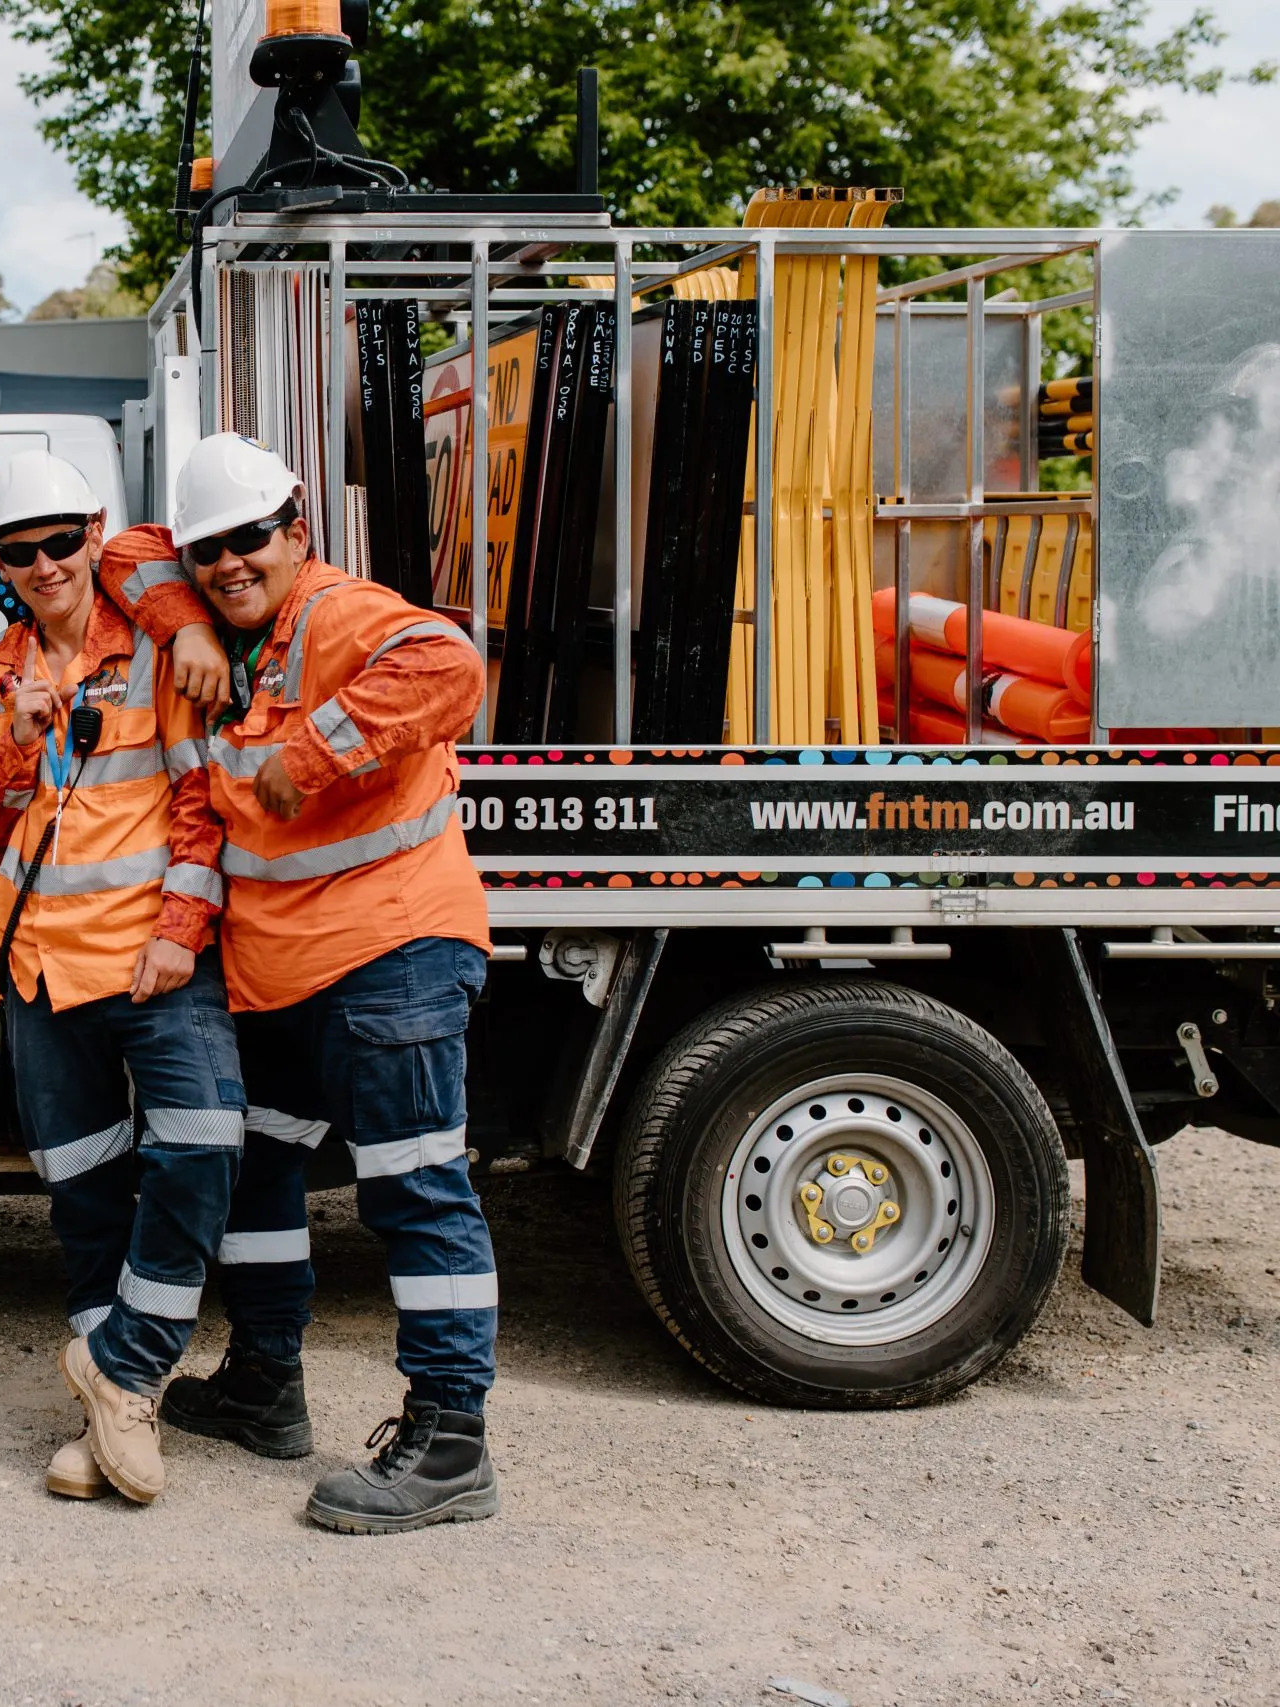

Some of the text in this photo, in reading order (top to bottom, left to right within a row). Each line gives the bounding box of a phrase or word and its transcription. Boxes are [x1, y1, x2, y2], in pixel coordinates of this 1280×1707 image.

[590, 324, 605, 387] MERGE
[693, 311, 708, 363] 17 PED
[714, 311, 729, 364] 18 PED
[727, 327, 740, 374] MISC
[742, 327, 756, 374] MISC
[455, 541, 508, 610] WRK
[515, 797, 584, 831] 313
[594, 797, 658, 831] 311
[750, 792, 1134, 830] www.fntm.com.au
[1214, 795, 1280, 832] Fin
